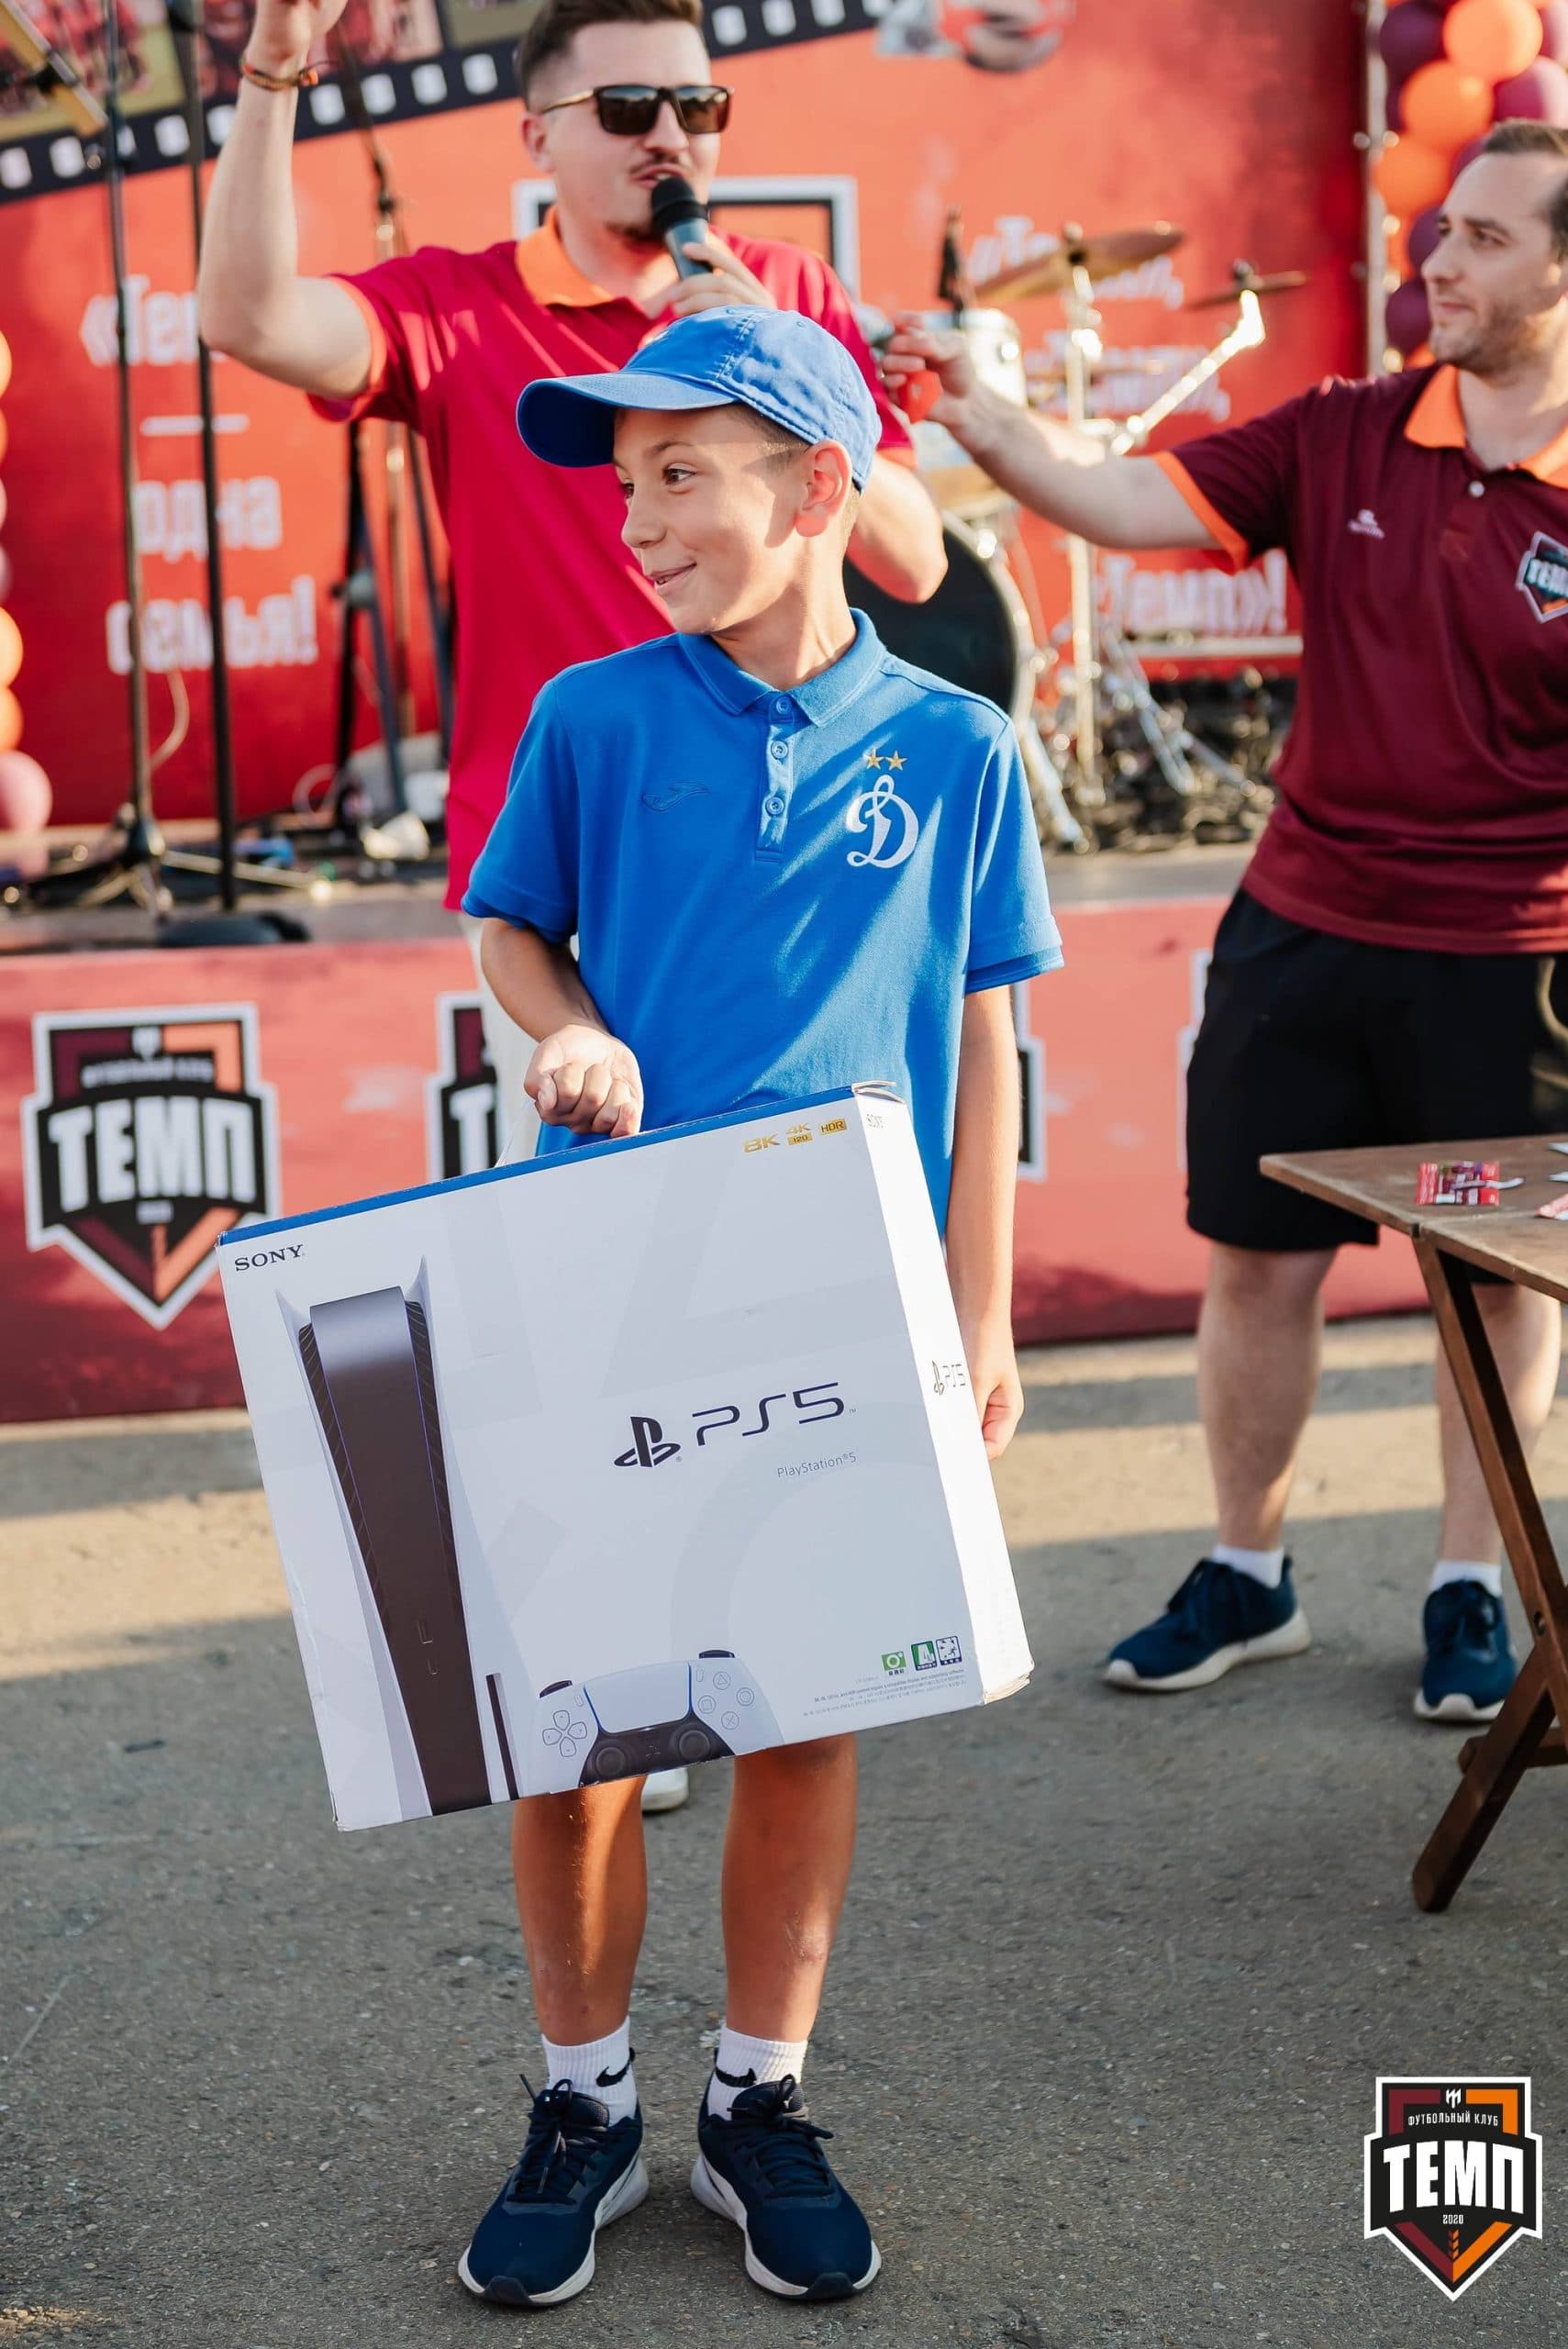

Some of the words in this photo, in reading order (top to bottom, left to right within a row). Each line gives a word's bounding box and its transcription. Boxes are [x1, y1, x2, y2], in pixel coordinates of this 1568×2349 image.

[130, 475, 283, 563] одна
[818, 1119, 846, 1134] HDR
[49, 1096, 256, 1212] ТЕМП
[744, 1132, 781, 1153] 8K
[234, 1243, 304, 1272] SONY
